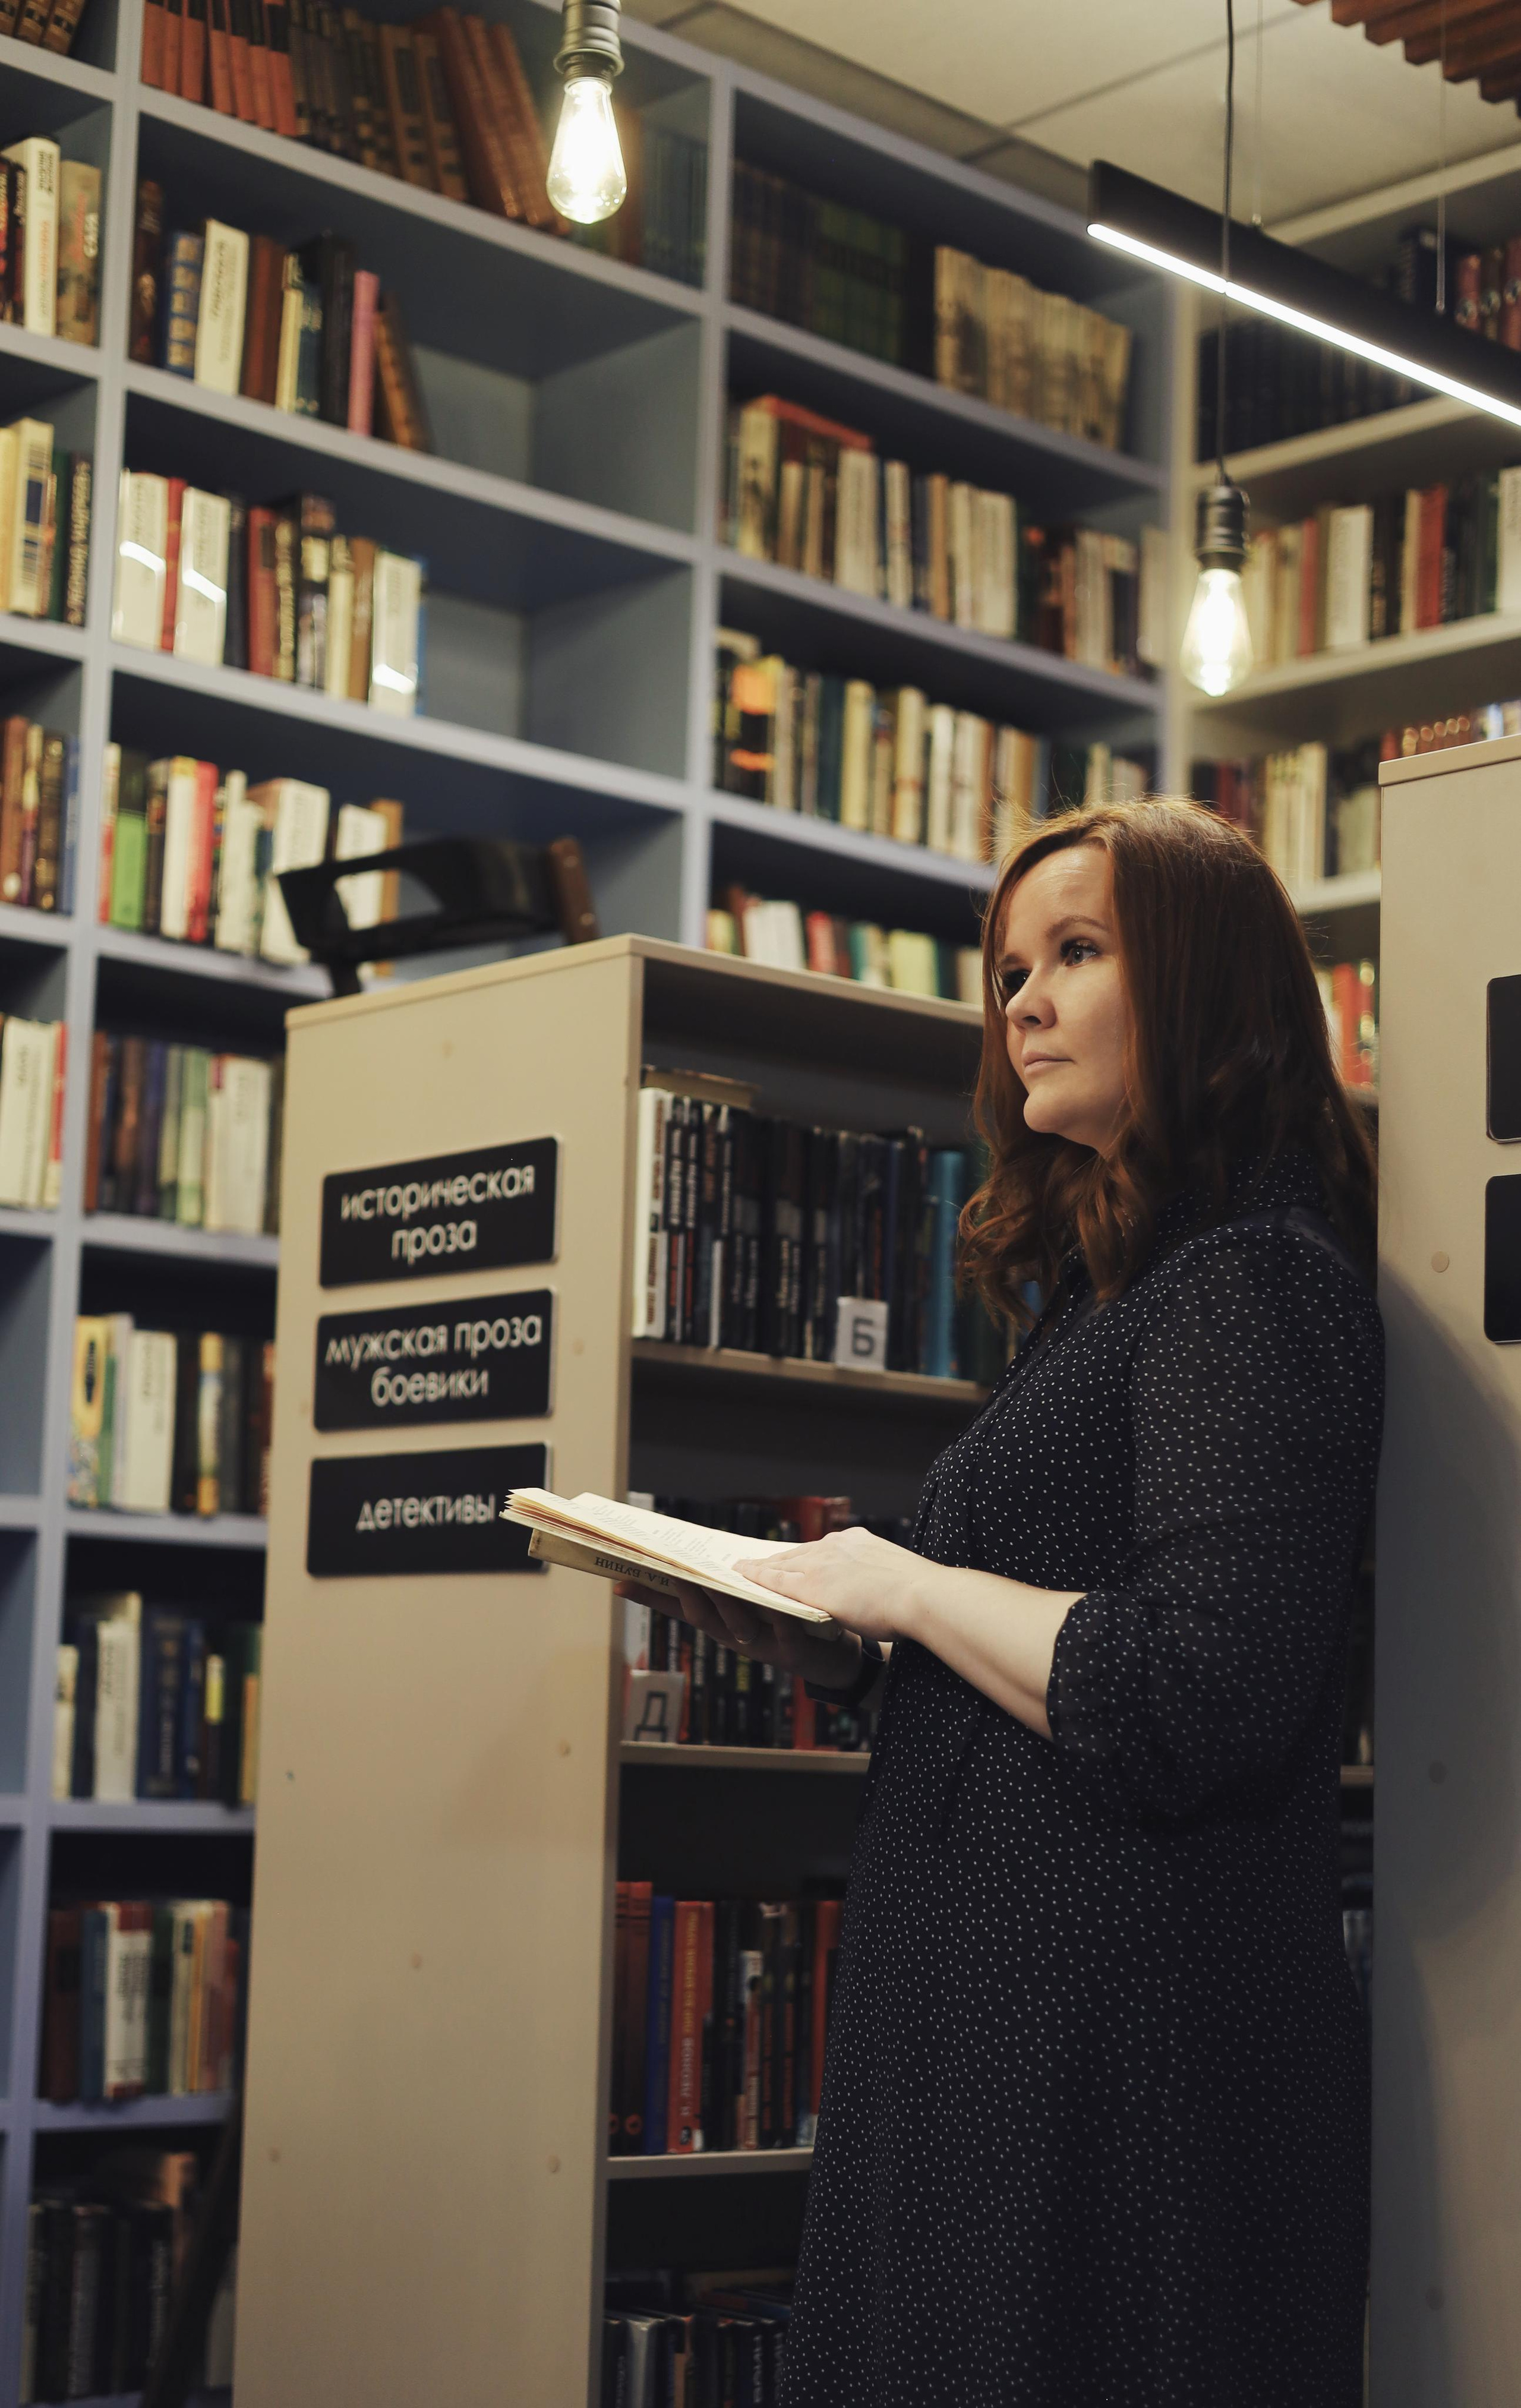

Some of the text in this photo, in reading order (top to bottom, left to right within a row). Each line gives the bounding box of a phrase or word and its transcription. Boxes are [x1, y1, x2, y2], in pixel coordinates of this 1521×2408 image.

[340, 1164, 535, 1222] историческая
[391, 1219, 478, 1266] проза
[324, 1315, 542, 1372] мужская проза
[853, 1316, 876, 1357] Б
[371, 1366, 489, 1407] боевики
[356, 1494, 496, 1533] детективы
[594, 1556, 642, 1578] БУНИН
[633, 1691, 668, 1741] Д
